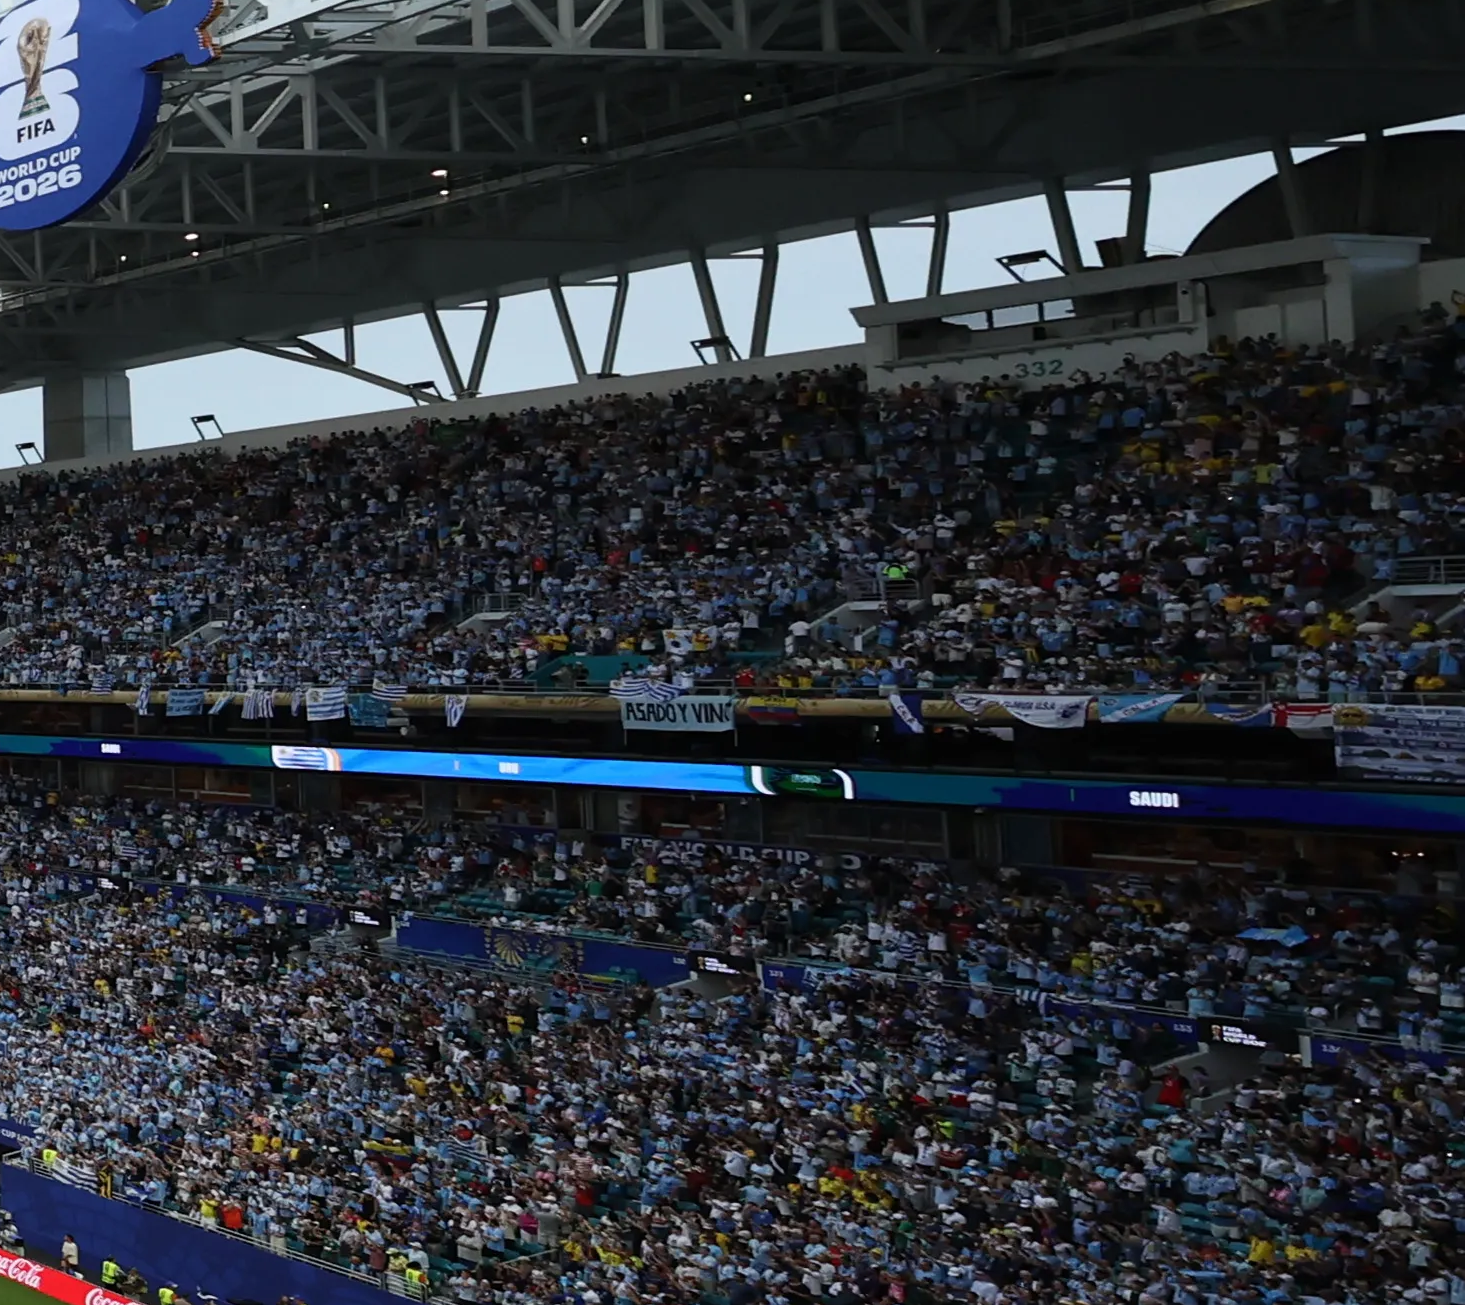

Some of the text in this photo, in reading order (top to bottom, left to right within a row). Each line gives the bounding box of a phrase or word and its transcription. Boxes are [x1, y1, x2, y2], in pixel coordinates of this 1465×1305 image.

[17, 118, 55, 144] FIFA
[49, 146, 81, 167] CUP
[1016, 359, 1064, 379] 332
[626, 702, 678, 722] ASADO
[1130, 791, 1179, 808] SAUDI
